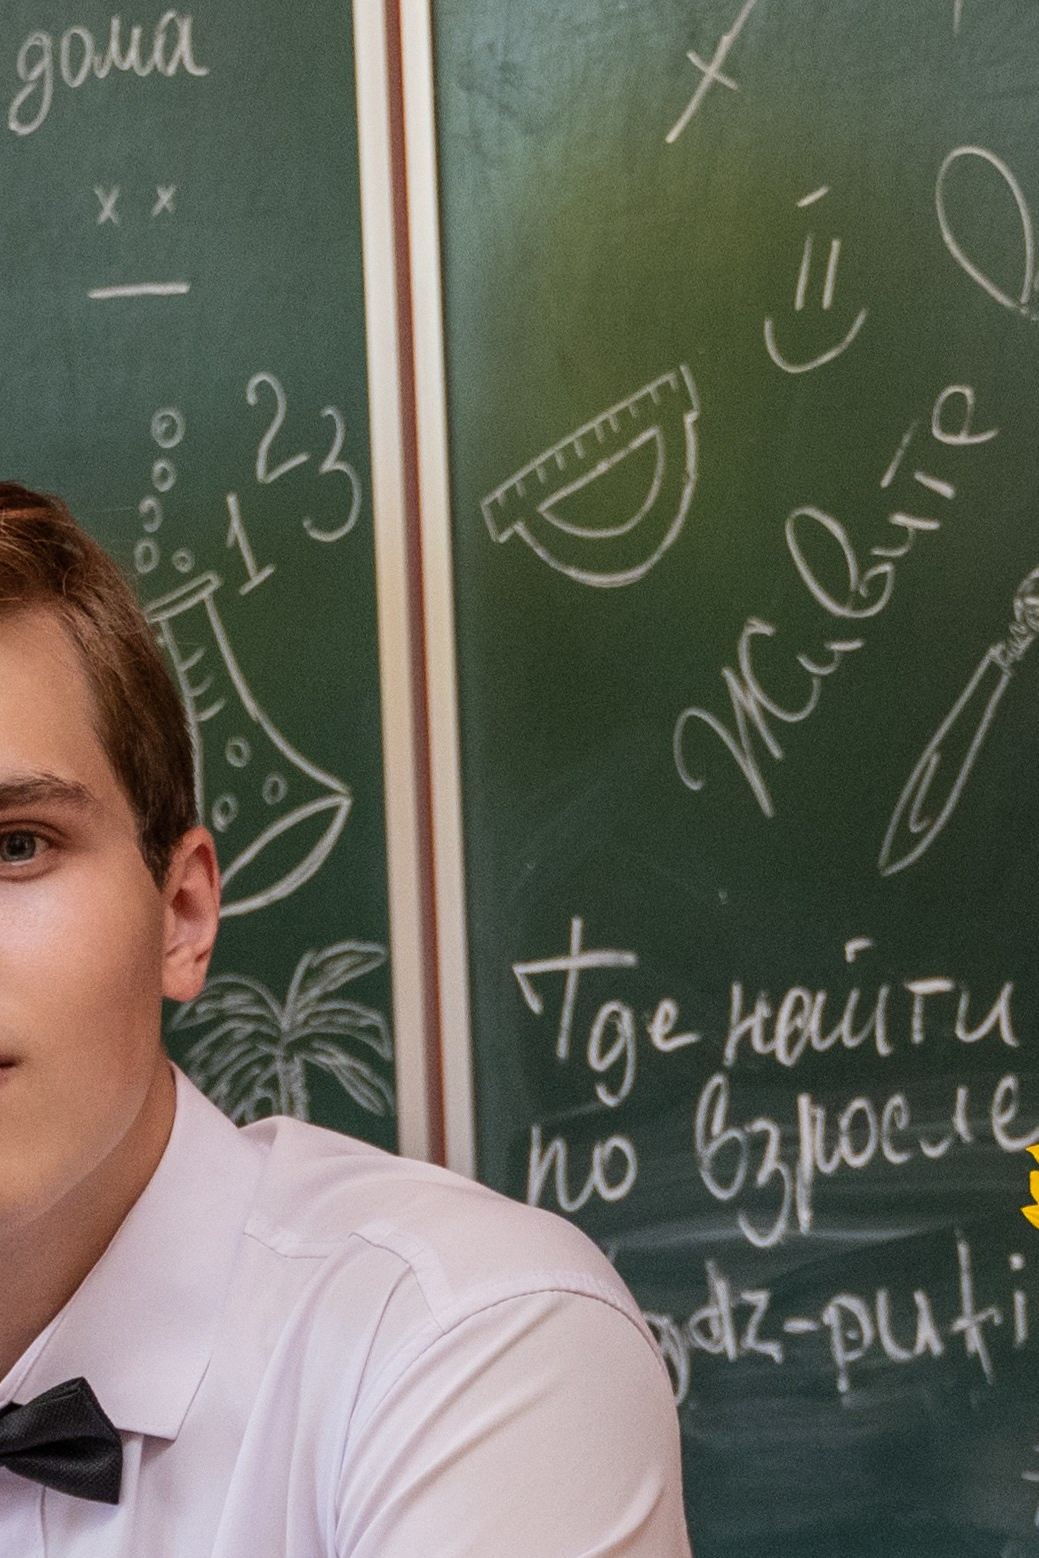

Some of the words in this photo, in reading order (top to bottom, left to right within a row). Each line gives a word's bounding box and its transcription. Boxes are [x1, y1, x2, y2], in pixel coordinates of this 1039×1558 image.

[8, 10, 210, 136] дома
[723, 937, 1021, 1069] найти
[528, 1123, 639, 1213] по
